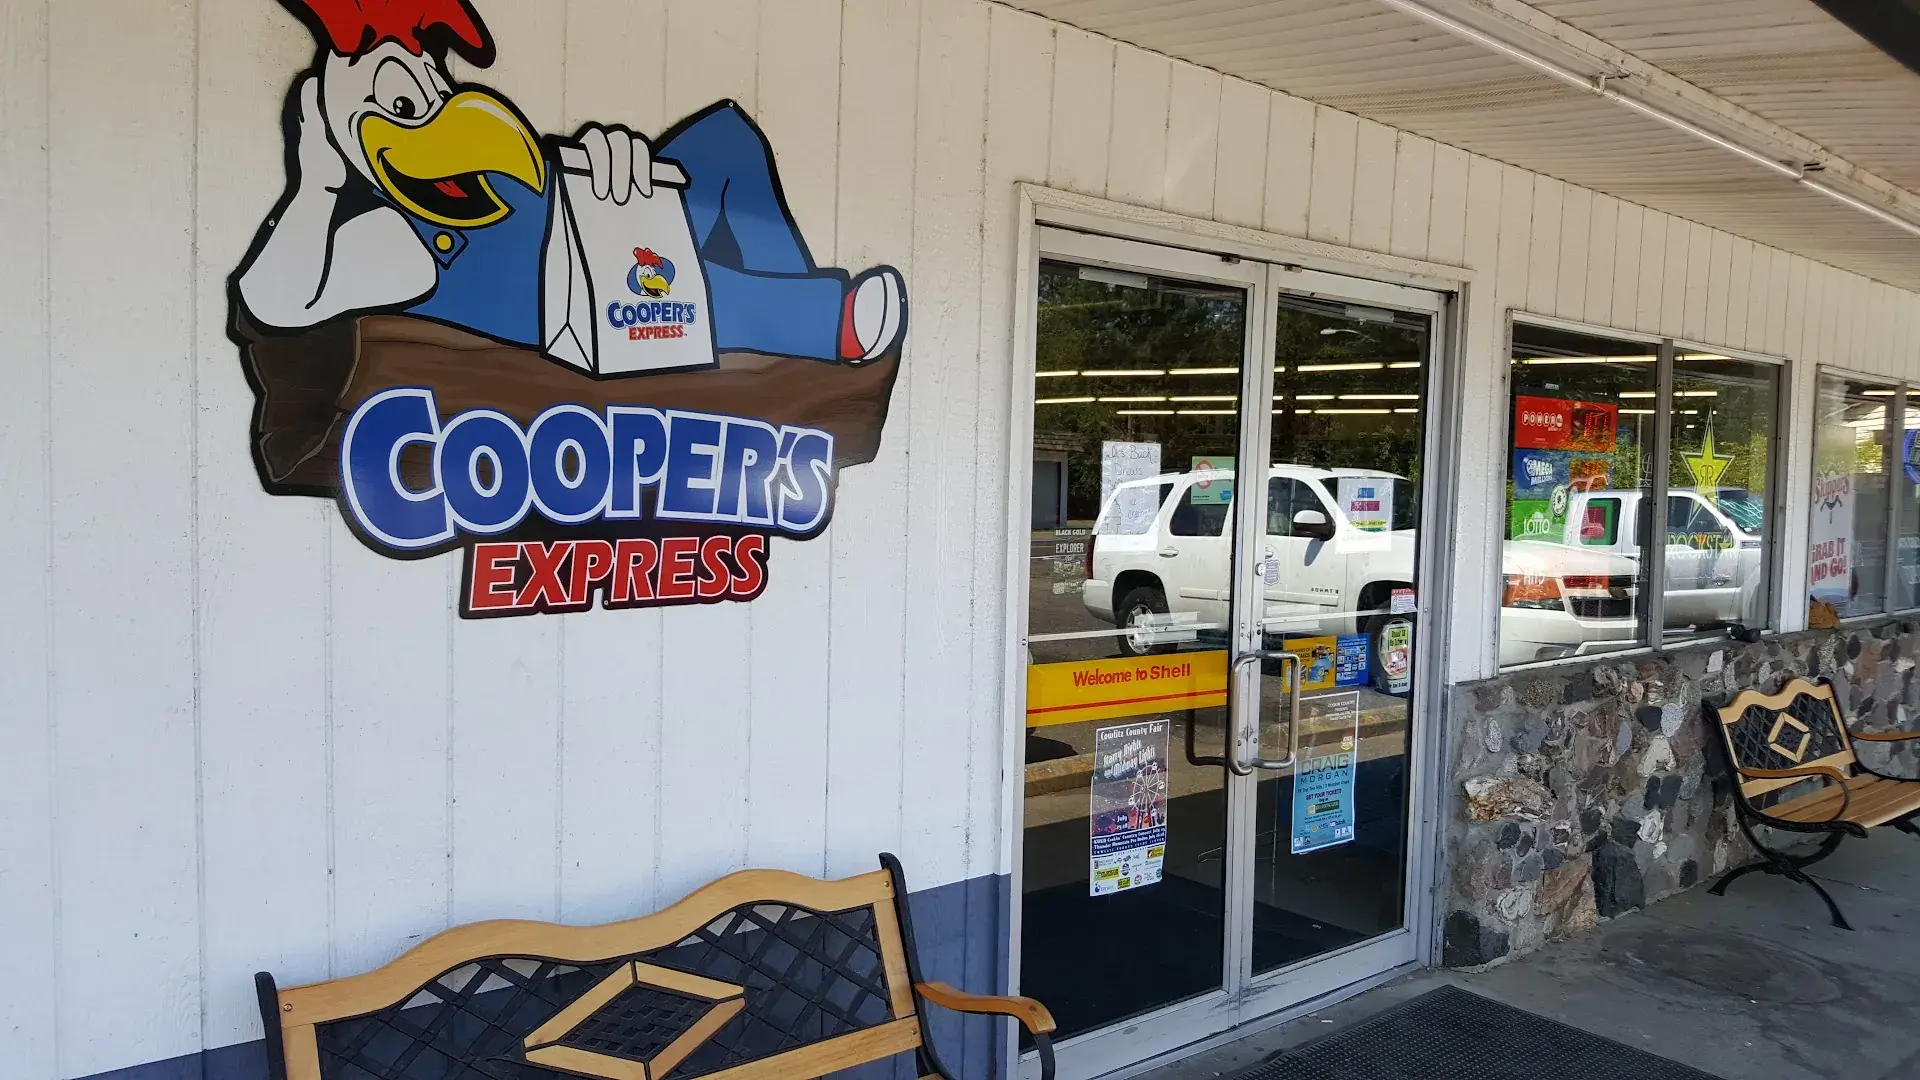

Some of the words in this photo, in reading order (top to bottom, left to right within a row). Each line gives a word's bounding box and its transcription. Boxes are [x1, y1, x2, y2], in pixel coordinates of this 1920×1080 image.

[607, 300, 696, 329] COOPER'S
[629, 325, 684, 341] EXPRESS
[340, 386, 836, 549] COOPER'S
[1524, 519, 1550, 534] LOTTO
[1055, 542, 1084, 554] EXPLORER
[1837, 537, 1846, 556] IT
[468, 535, 765, 612] EXPRESS
[1830, 555, 1847, 577] GO!
[1073, 668, 1132, 687] Welcome
[1136, 667, 1148, 681] to
[1150, 663, 1191, 680] Shell
[1101, 730, 1124, 741] Cowlitz
[1126, 726, 1148, 737] County
[1149, 722, 1163, 733] Fair
[1301, 754, 1349, 776] CRAIG
[1301, 769, 1348, 785] MORGAN
